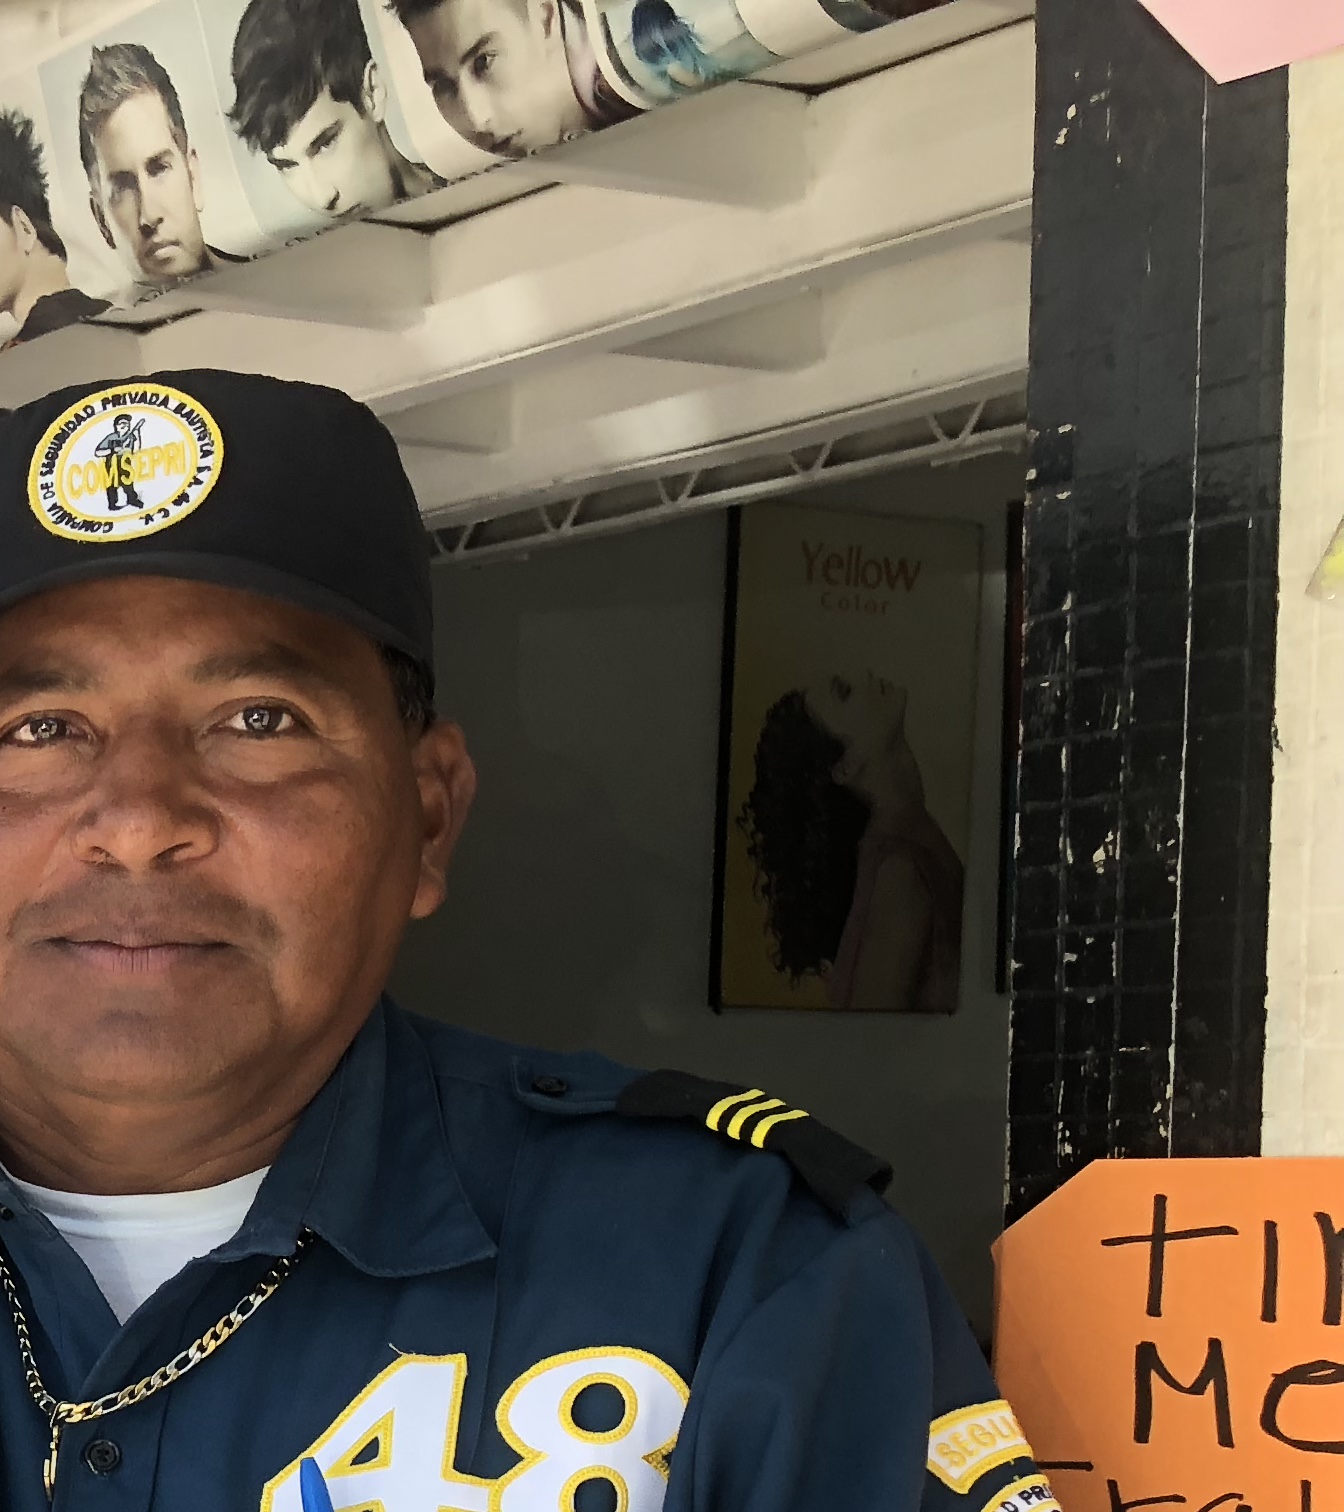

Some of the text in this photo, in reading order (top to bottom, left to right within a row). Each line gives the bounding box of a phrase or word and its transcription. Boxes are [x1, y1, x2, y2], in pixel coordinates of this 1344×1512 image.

[101, 390, 170, 411] PRIVADA
[66, 440, 187, 499] COMSEPRI
[801, 540, 923, 593] Yellow
[935, 1415, 1026, 1468] SEGU
